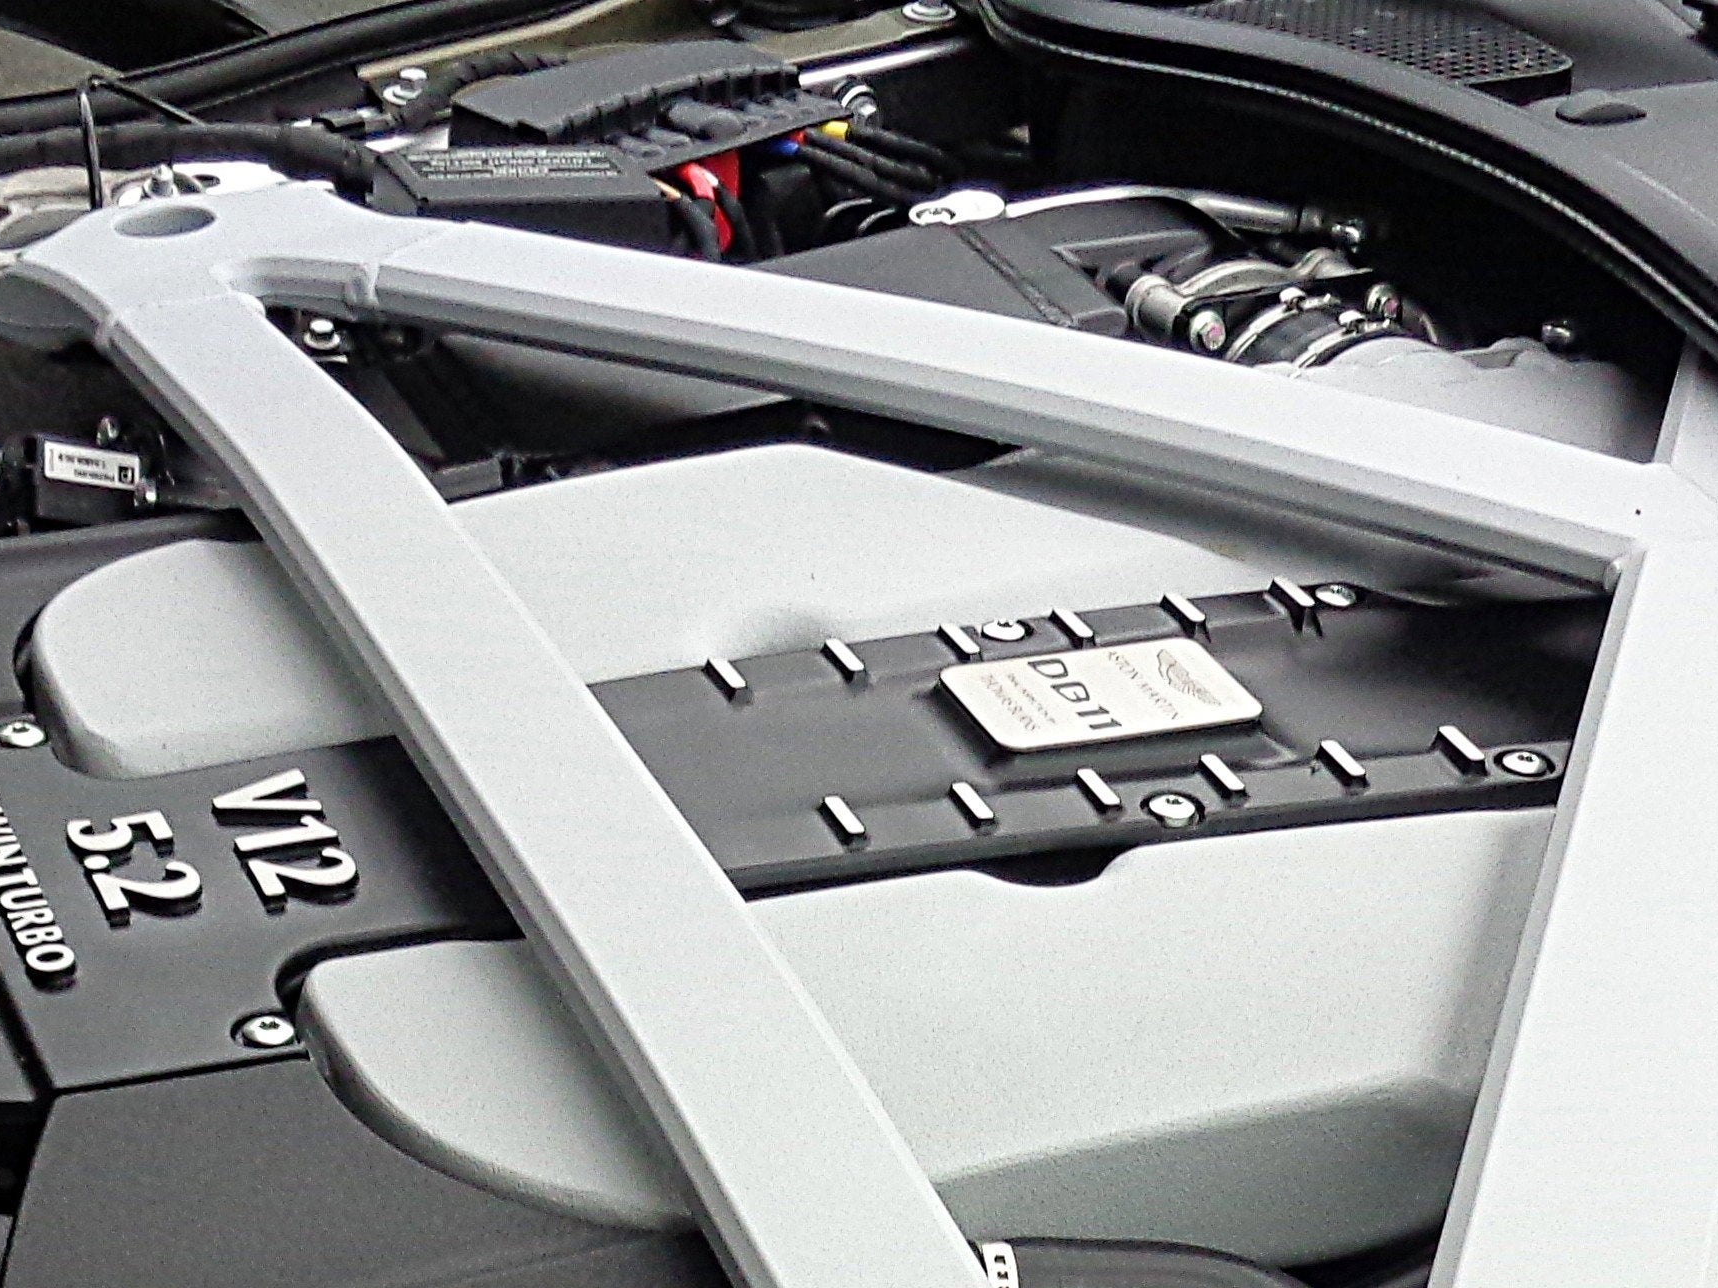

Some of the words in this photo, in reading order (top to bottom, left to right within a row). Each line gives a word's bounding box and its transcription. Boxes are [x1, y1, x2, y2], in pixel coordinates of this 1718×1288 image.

[1027, 657, 1123, 731] DB11
[66, 809, 202, 914] 5.2
[211, 767, 359, 898] V12
